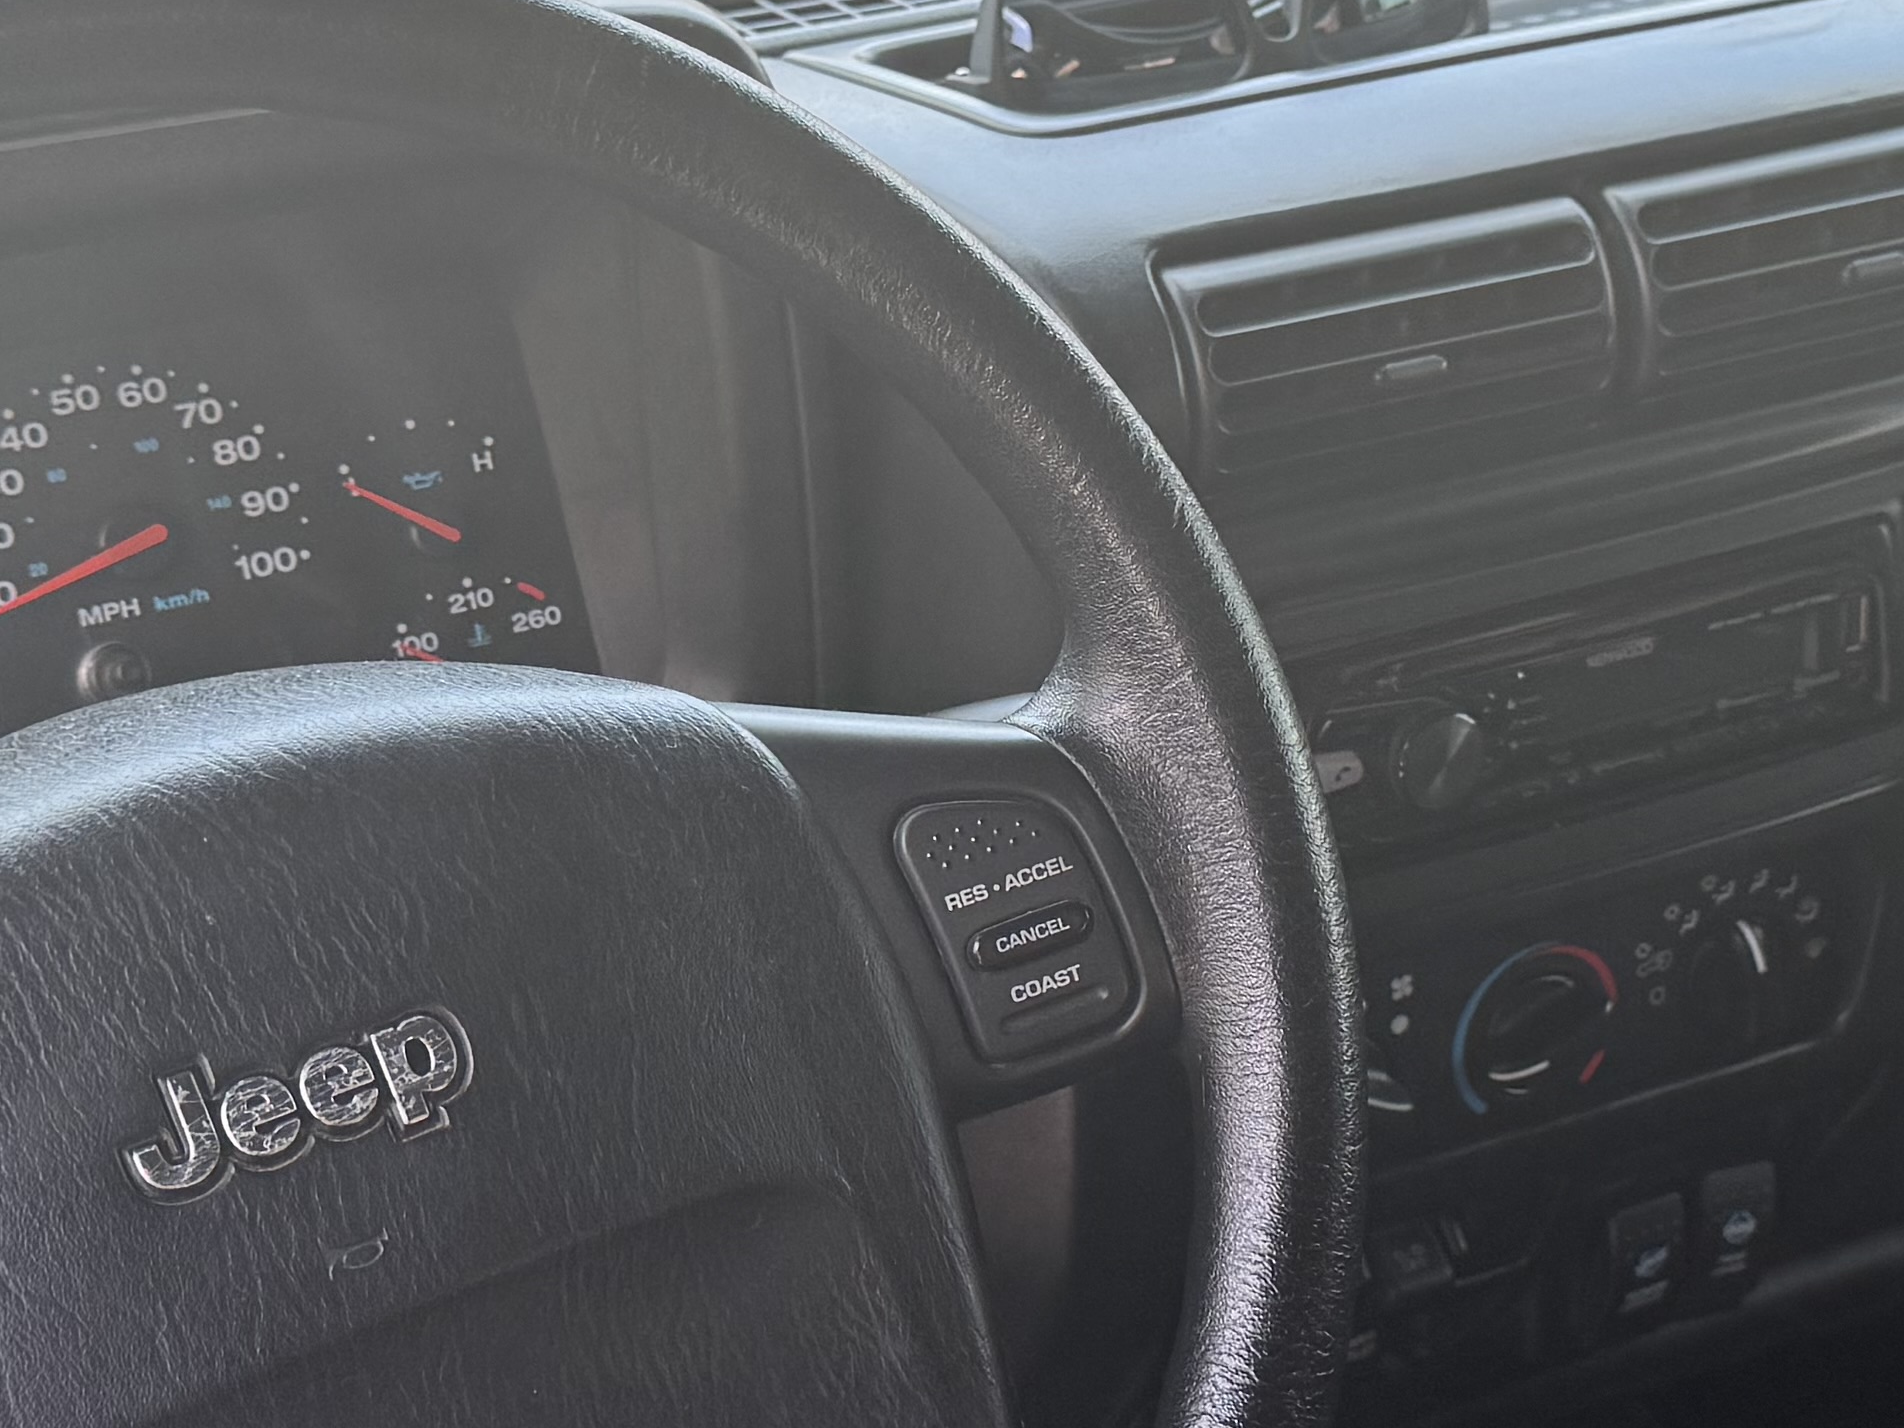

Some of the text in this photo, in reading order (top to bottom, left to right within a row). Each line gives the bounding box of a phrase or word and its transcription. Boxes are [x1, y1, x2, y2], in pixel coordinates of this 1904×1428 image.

[50, 384, 100, 415] 50
[117, 377, 167, 408] 60
[174, 398, 223, 429] 70
[213, 435, 261, 465] 80
[472, 451, 494, 473] H
[241, 486, 289, 517] 90
[234, 547, 297, 580] 100
[77, 587, 210, 627] MPH km/h
[448, 588, 494, 614] 210
[511, 606, 562, 633] 260
[392, 632, 439, 658] 100
[944, 855, 1074, 912] RES ACCEL
[995, 916, 1071, 954] CANCEL
[1010, 963, 1081, 1004] COAST
[126, 1010, 466, 1197] Jeep
